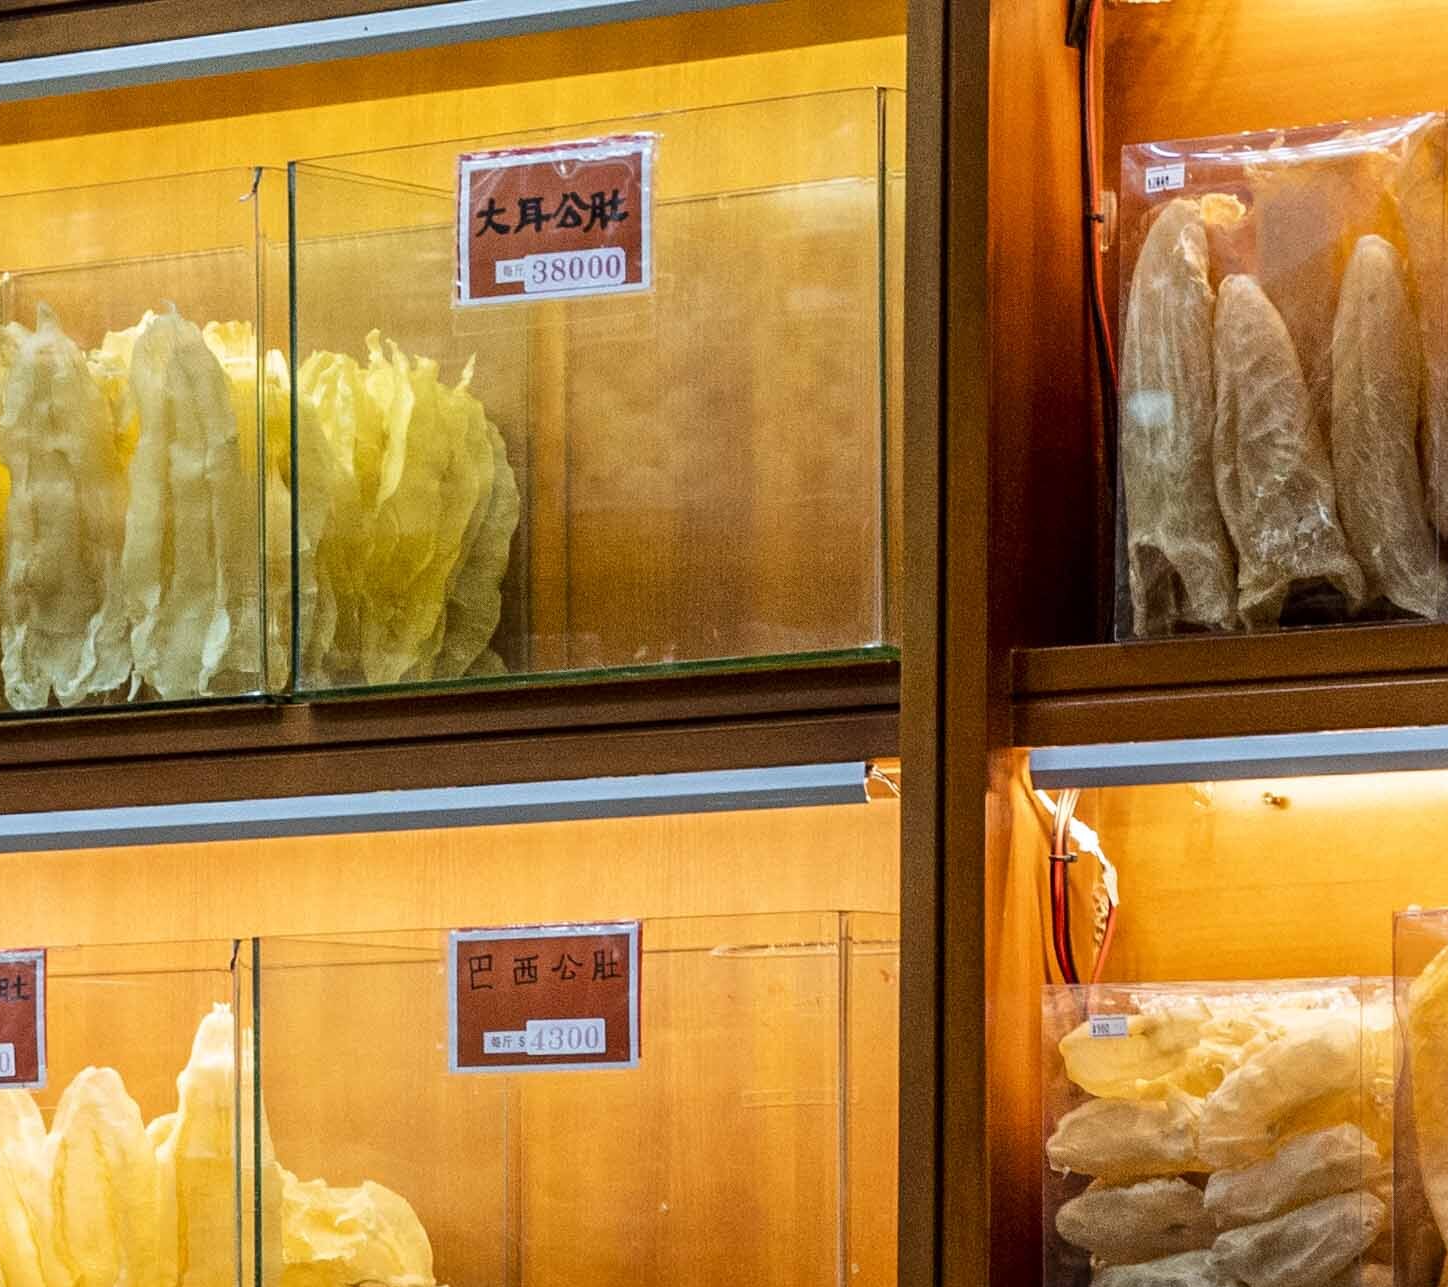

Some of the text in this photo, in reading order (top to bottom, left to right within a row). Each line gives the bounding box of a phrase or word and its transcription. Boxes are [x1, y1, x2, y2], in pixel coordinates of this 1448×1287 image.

[475, 188, 629, 238] 大耳公肚
[531, 254, 621, 285] 38000
[469, 950, 624, 990] 巴西公肚
[530, 1025, 599, 1051] 4300
